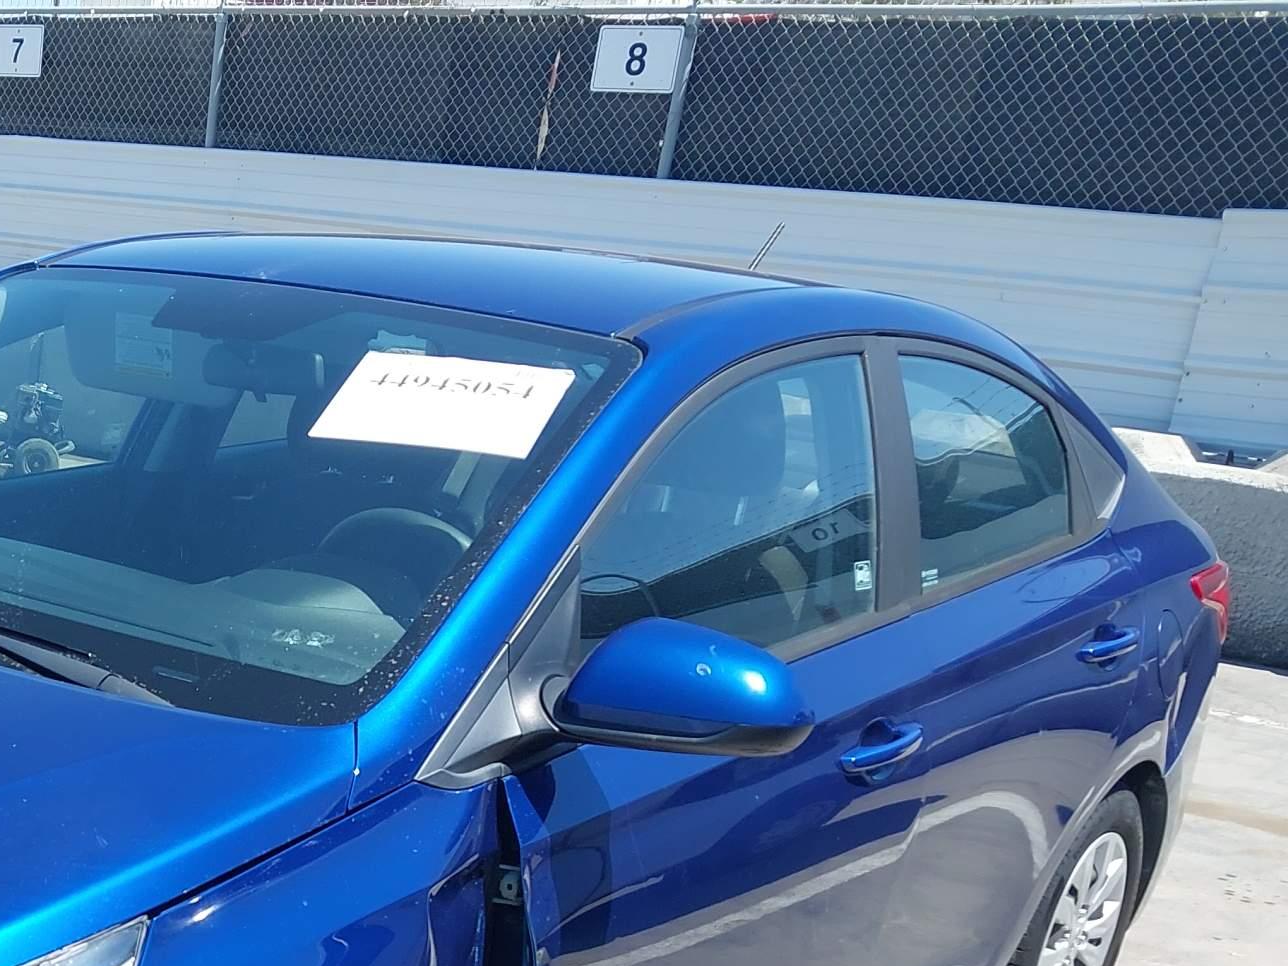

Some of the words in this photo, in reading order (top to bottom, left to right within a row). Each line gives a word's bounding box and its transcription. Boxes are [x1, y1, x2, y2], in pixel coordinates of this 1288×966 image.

[12, 38, 24, 63] 7
[625, 42, 647, 76] 8
[371, 373, 534, 399] 44945054
